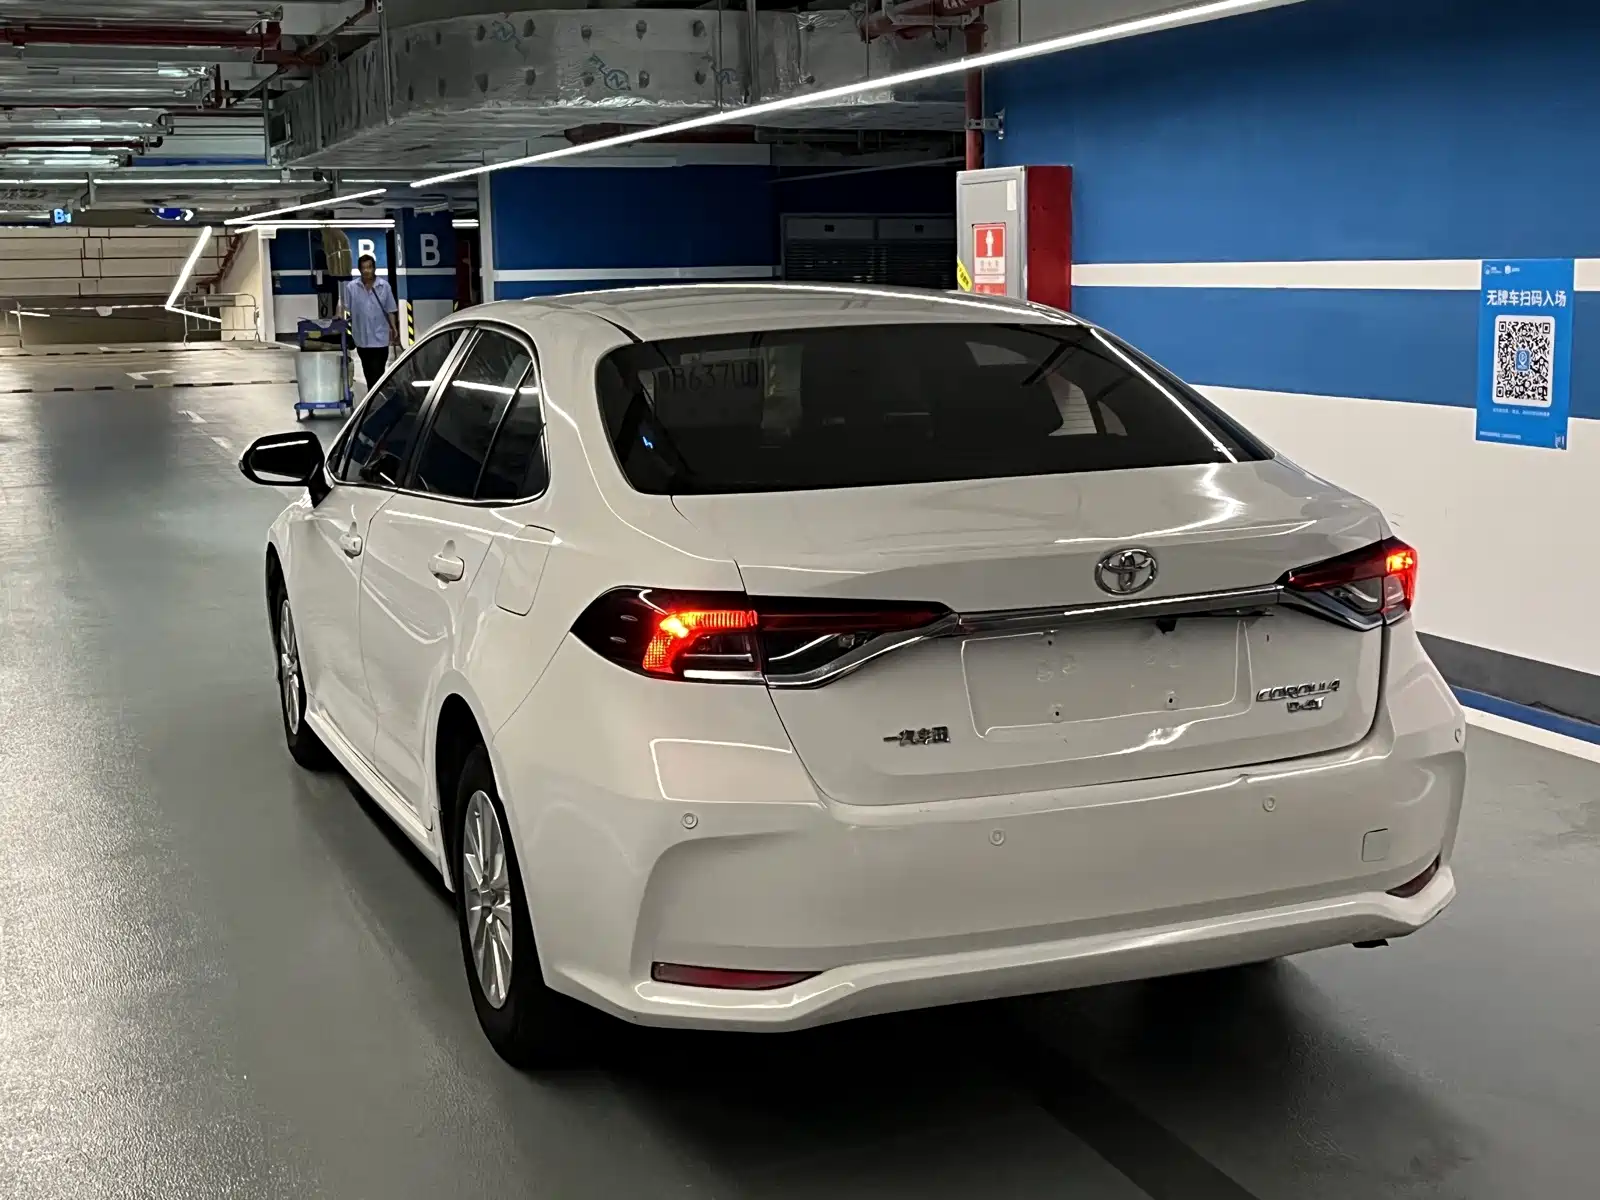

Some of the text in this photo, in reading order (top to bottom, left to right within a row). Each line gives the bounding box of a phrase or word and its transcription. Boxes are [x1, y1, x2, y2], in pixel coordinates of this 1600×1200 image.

[358, 239, 376, 261] B
[420, 234, 440, 266] B
[1486, 289, 1567, 307] 无牌车扫码入场
[1256, 679, 1340, 702] COROLLA
